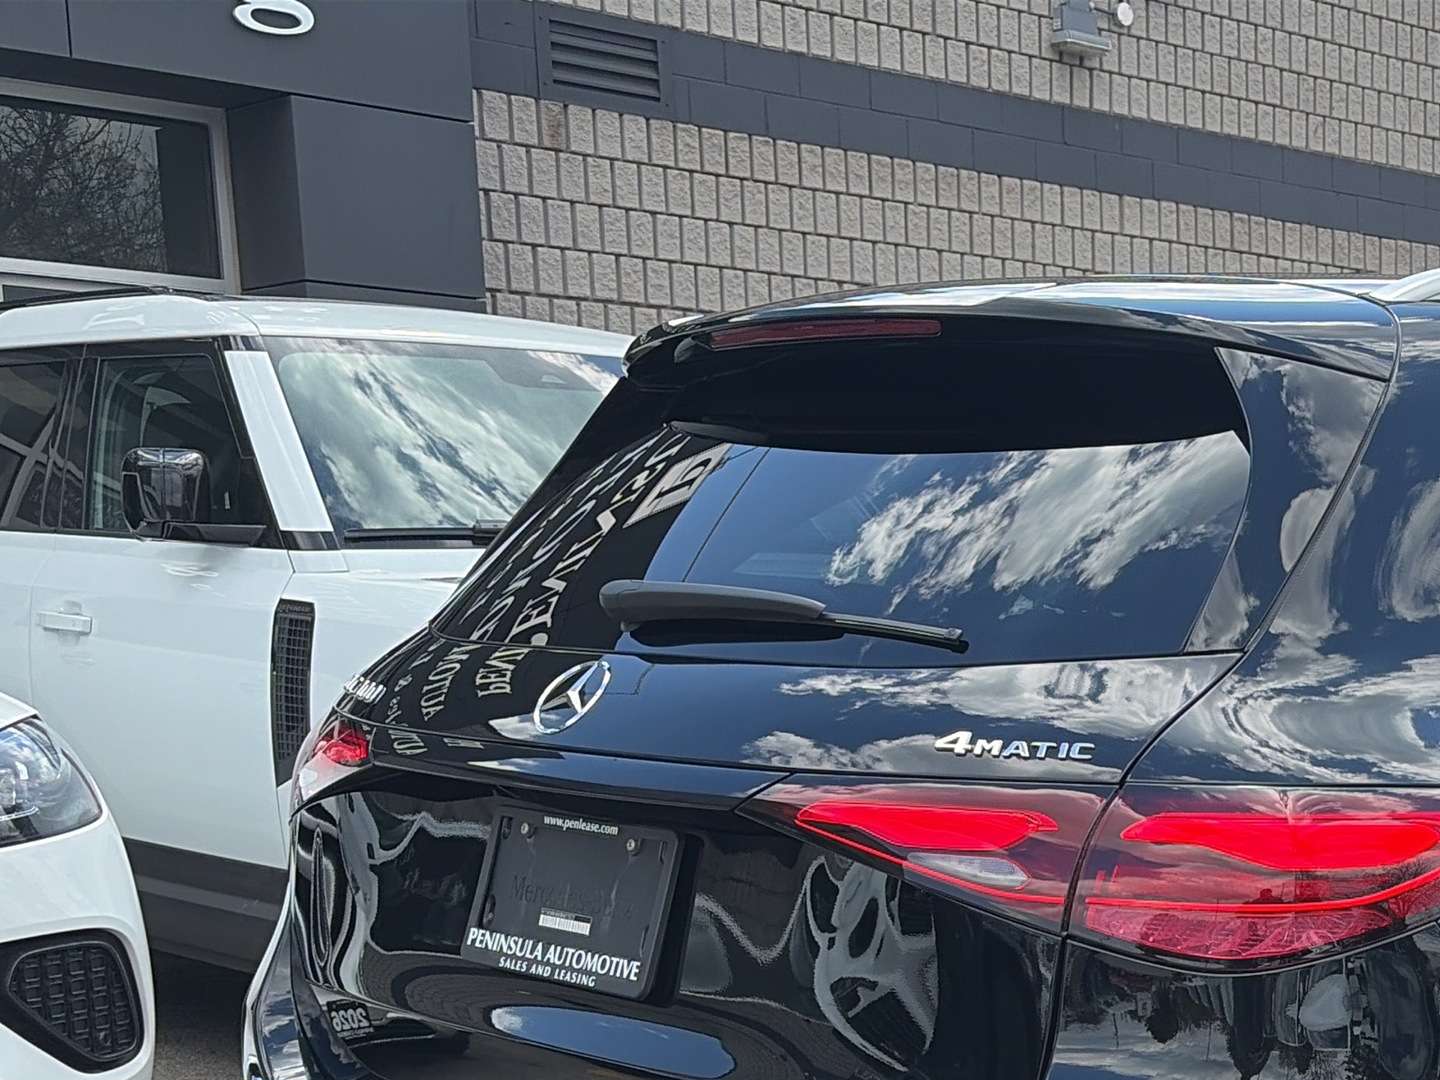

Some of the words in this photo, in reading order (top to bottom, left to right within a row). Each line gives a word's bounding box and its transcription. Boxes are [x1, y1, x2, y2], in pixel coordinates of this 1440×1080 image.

[934, 730, 1095, 760] 4MATIC
[544, 815, 619, 836] www.penlease.com
[466, 926, 543, 962] PENINSULA
[544, 943, 641, 981] AUTOMOTIVE
[499, 956, 527, 973] SALES
[529, 962, 551, 977] AND
[553, 968, 596, 987] LEASING
